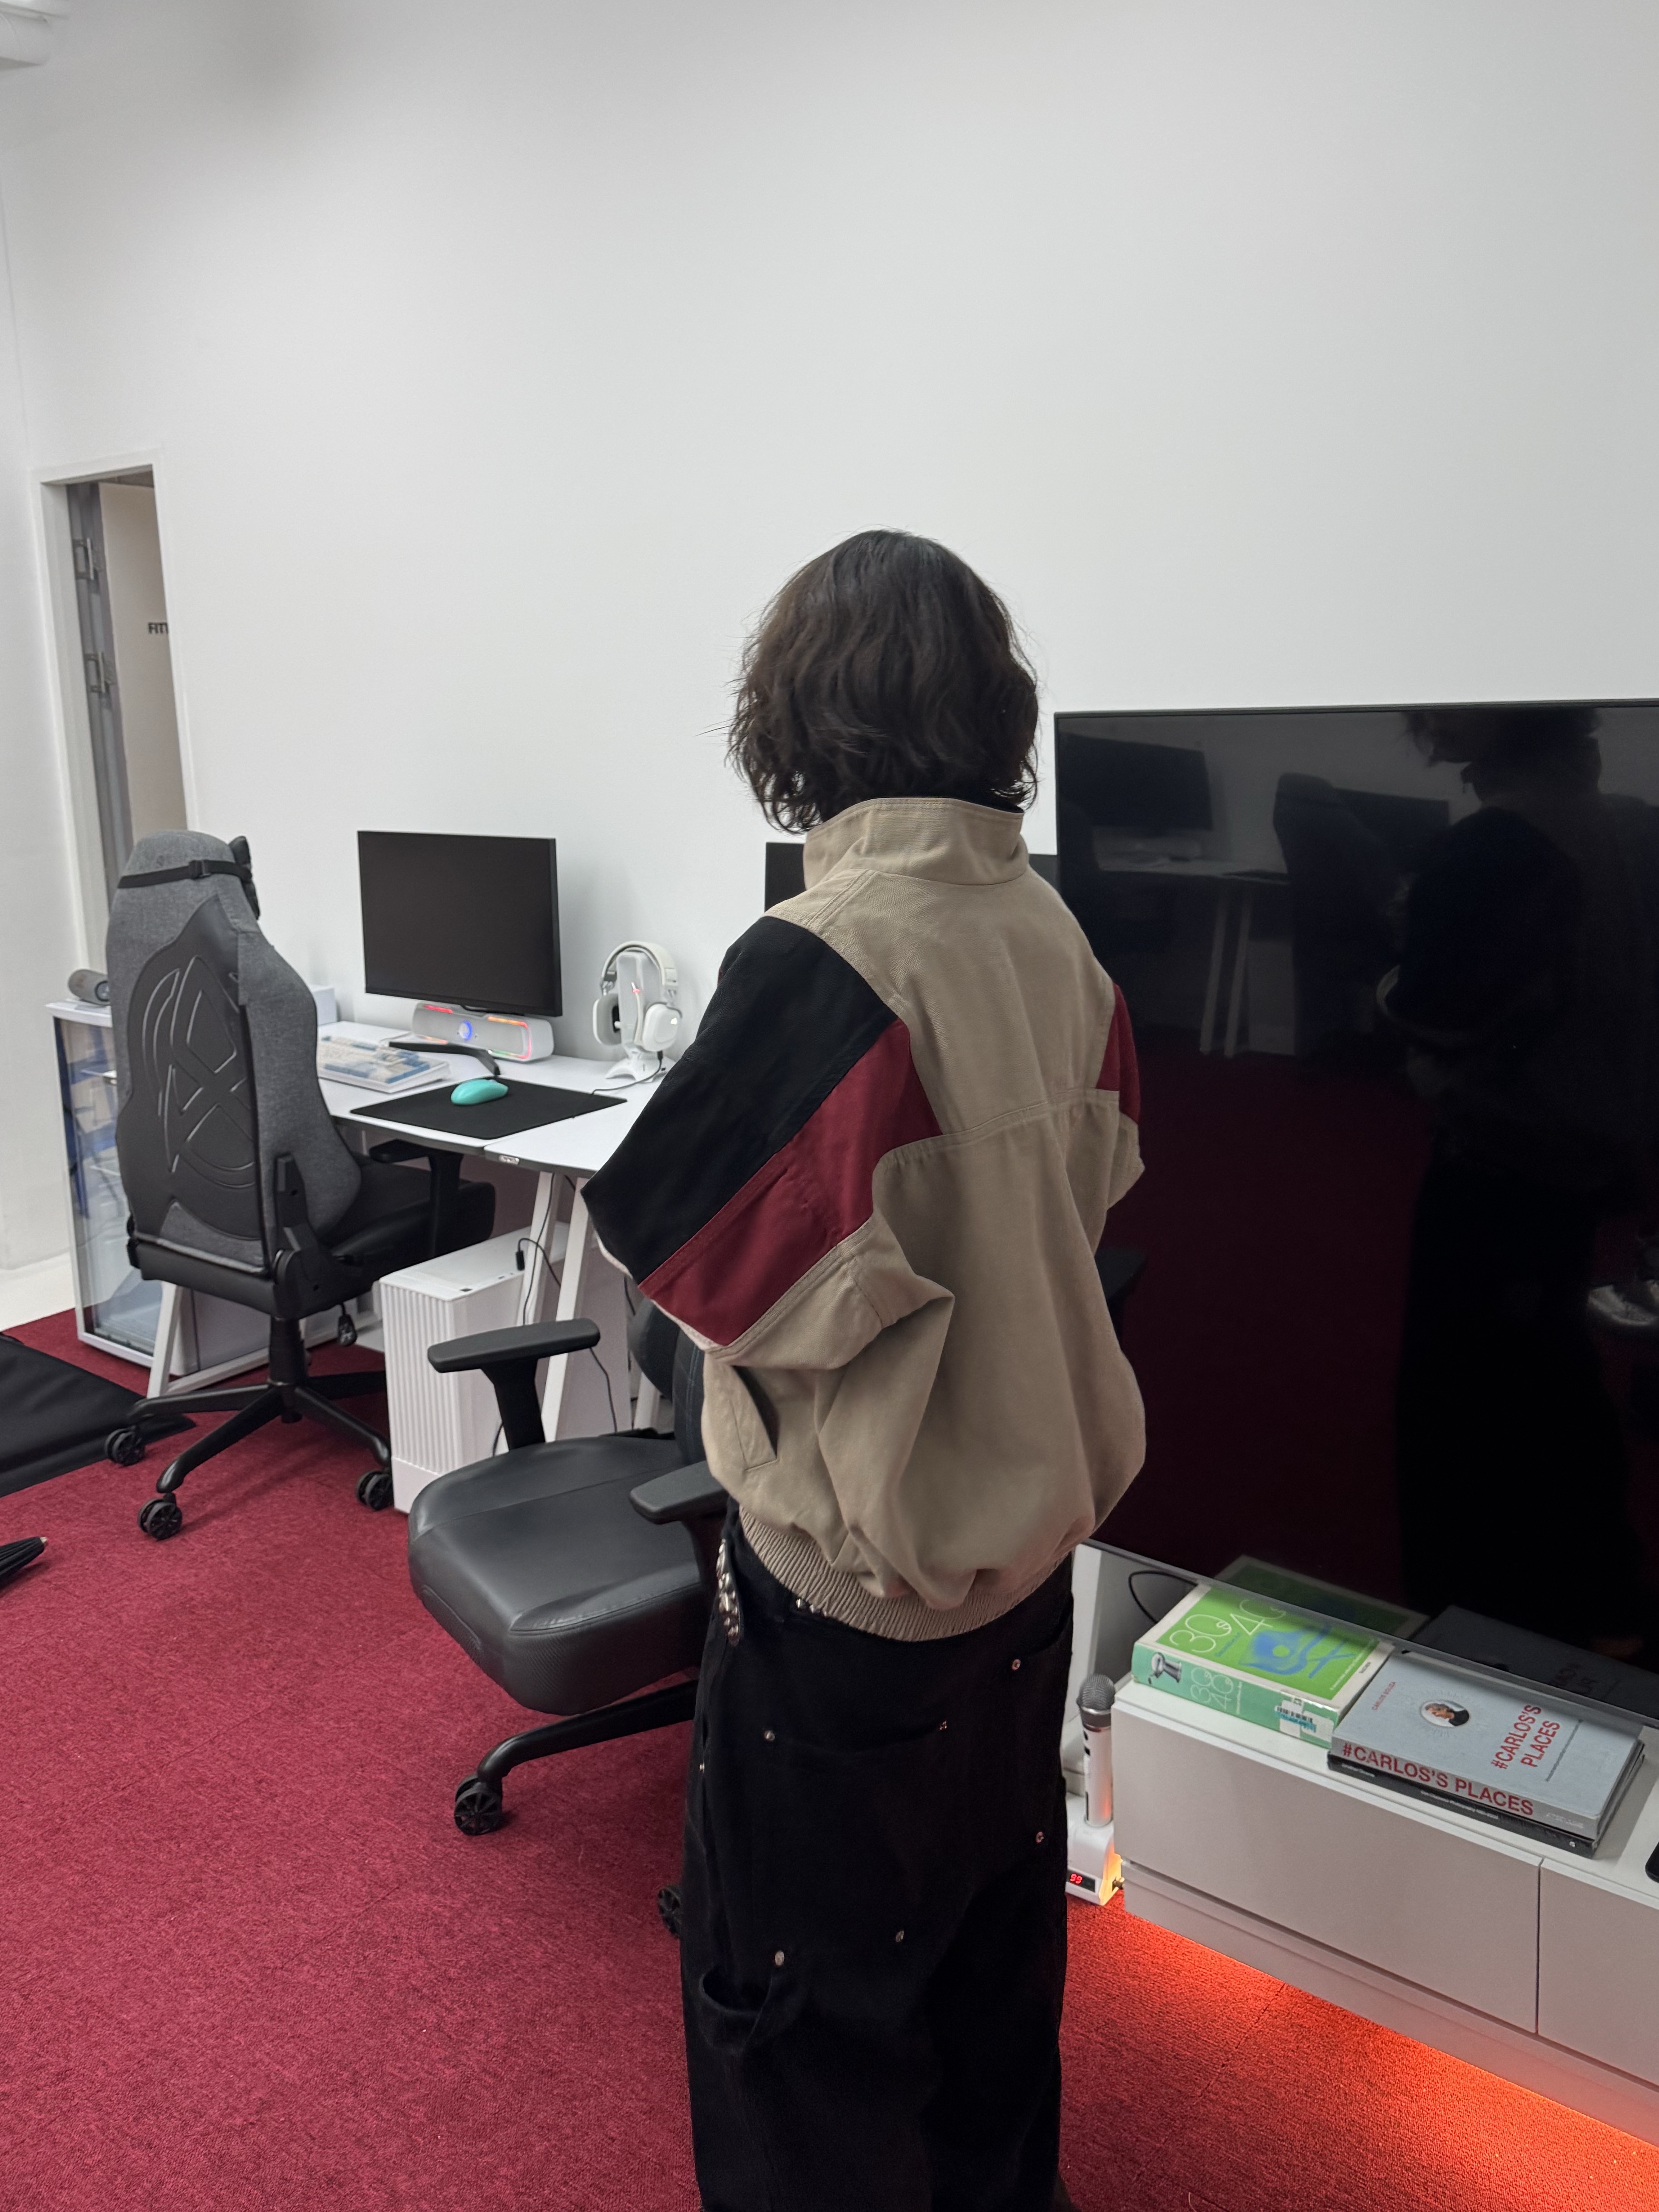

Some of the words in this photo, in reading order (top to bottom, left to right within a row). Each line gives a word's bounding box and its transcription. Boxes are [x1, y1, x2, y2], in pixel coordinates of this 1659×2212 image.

[1169, 1614, 1232, 1653] 30s
[1490, 1704, 1542, 1769] #CARLOS'S
[1520, 1721, 1560, 1767] PLACES
[1343, 1742, 1448, 1788] #CARLOS'S
[1455, 1778, 1534, 1815] PLACES
